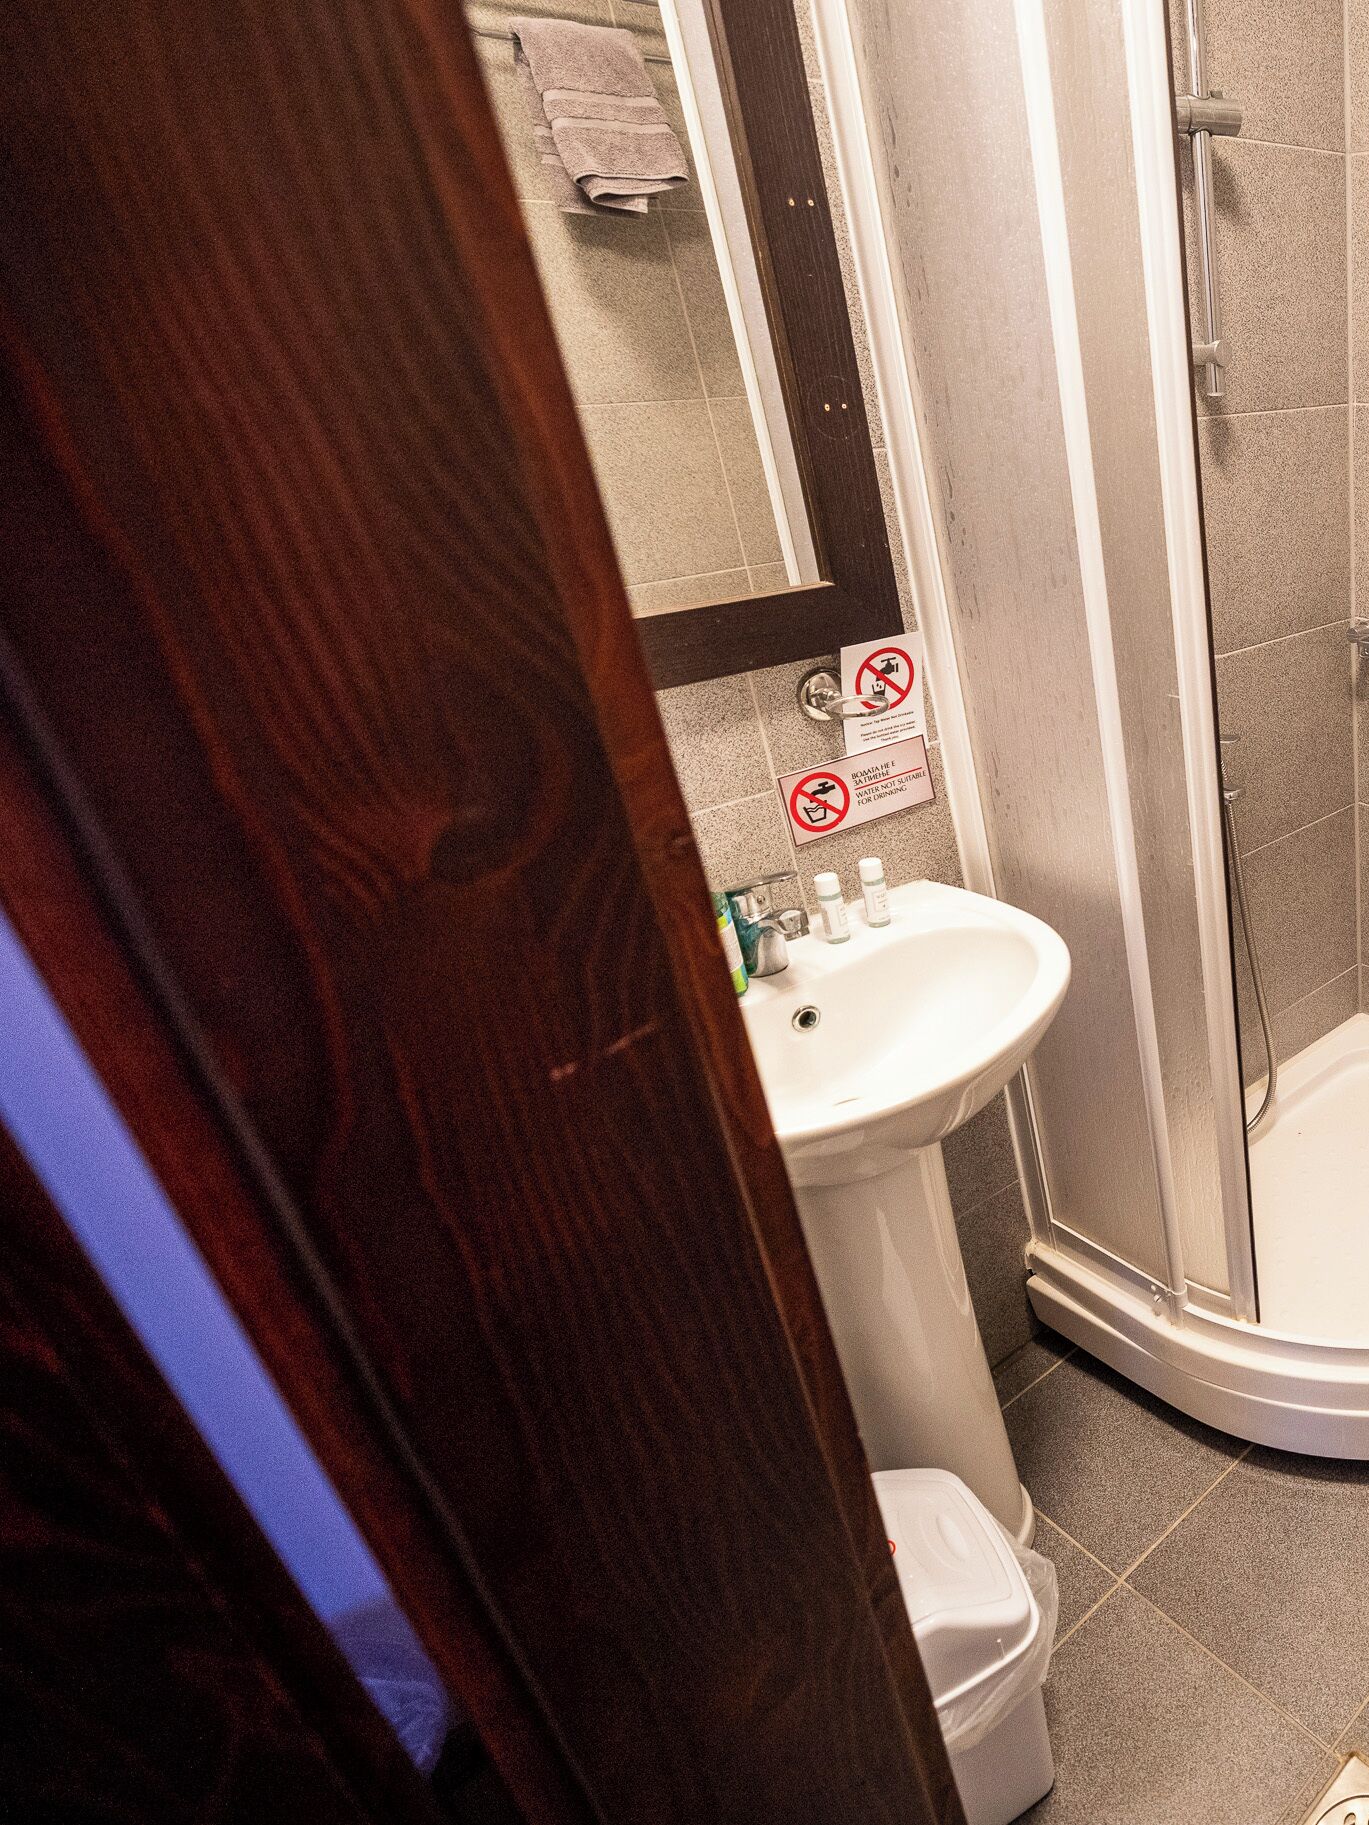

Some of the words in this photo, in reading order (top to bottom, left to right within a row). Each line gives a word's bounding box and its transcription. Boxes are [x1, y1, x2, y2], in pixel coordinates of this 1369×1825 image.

[851, 765, 880, 780] ВОДАТА
[880, 761, 890, 770] НЕ
[853, 778, 864, 786] ЗА
[864, 769, 890, 783] ПИЕЊЕ
[855, 786, 880, 798] WATER
[880, 780, 896, 791] NOT
[897, 770, 927, 784] SUITABLE
[857, 796, 873, 806] FOR
[873, 785, 908, 801] DRINKING
